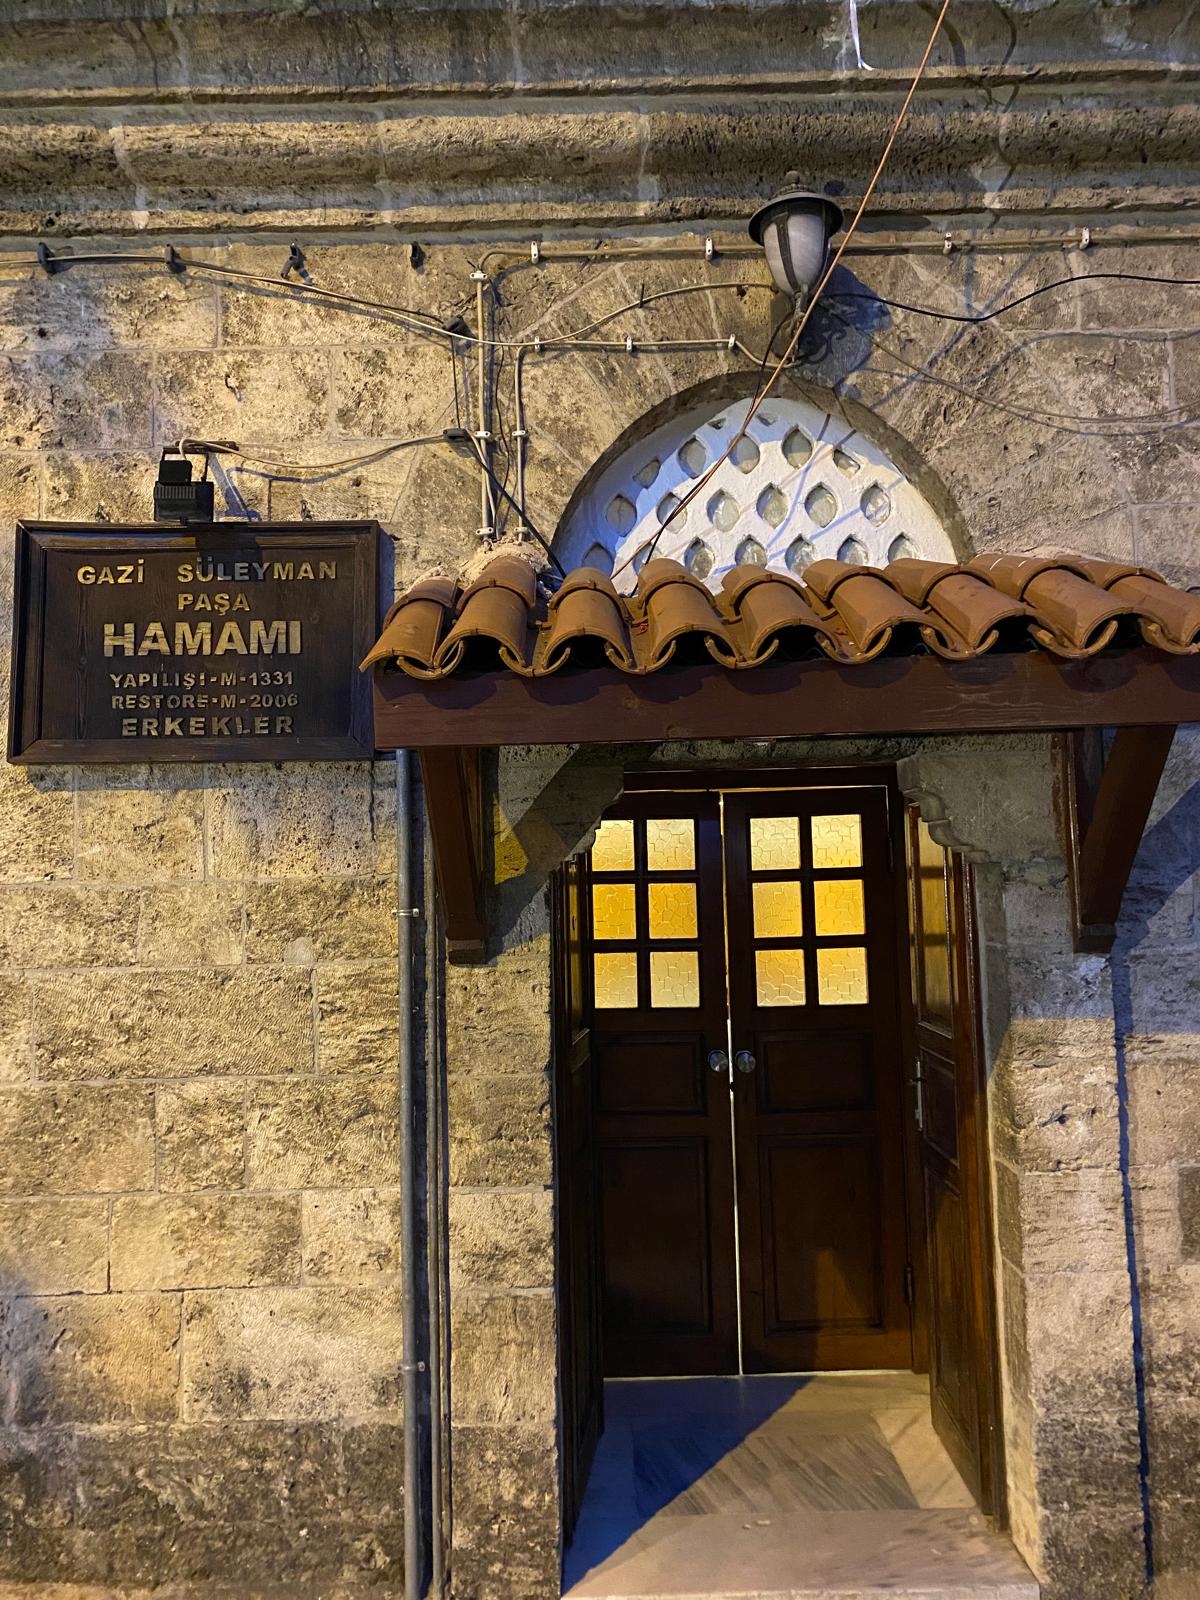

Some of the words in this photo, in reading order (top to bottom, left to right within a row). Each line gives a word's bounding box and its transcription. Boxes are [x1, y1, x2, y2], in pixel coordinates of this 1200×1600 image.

[77, 558, 145, 585] GAZİ
[176, 556, 337, 584] SÜLEYMAN
[177, 592, 251, 616] PAŞA
[103, 620, 302, 657] HAMAMI
[121, 715, 294, 737] ERKEKLER
